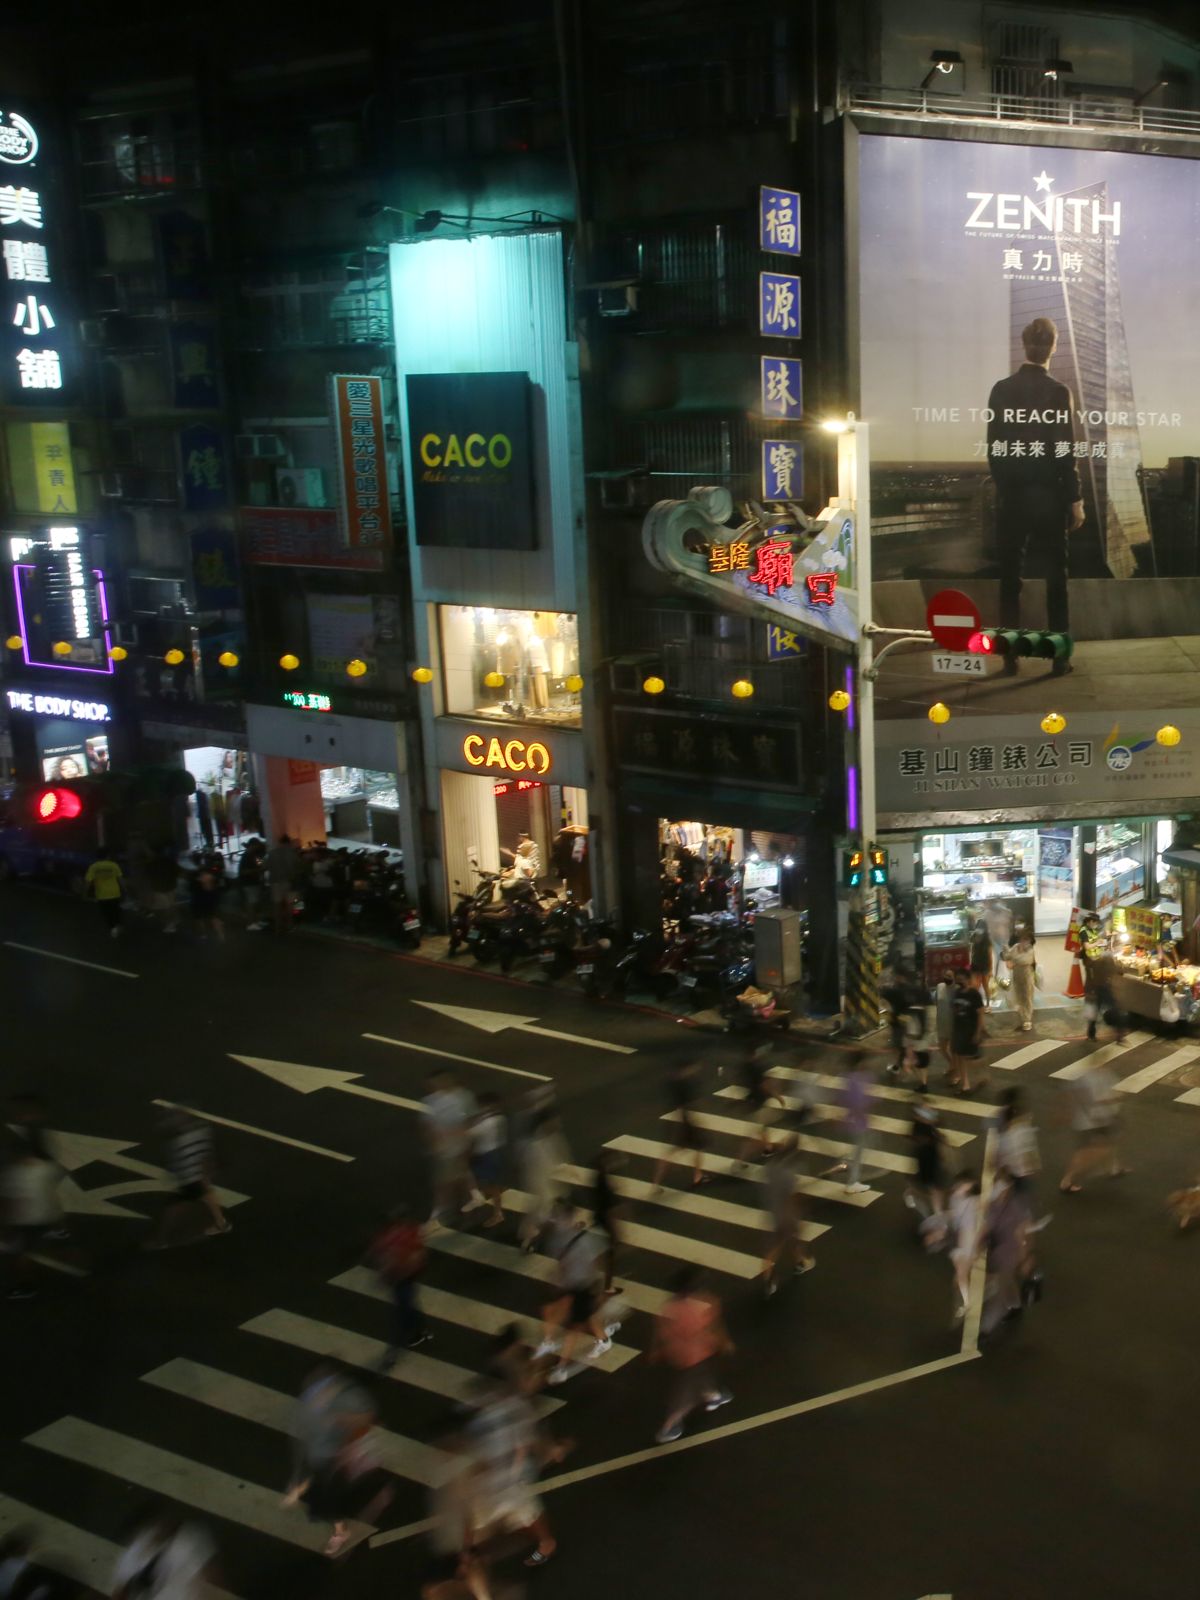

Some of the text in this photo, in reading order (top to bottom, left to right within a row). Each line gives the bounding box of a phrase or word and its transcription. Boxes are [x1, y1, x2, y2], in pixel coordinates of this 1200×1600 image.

[965, 192, 1121, 236] ZENITH
[1002, 248, 1084, 273] 真力時
[912, 408, 1182, 427] TIME TO REACH YOUR STAR
[420, 433, 512, 468] CACO
[973, 440, 1127, 459] 力創未來 夢想成真
[748, 539, 838, 606] 廟口
[936, 657, 982, 672] 17-24
[7, 691, 34, 710] THE
[34, 695, 72, 715] BODY
[463, 734, 552, 775] CACO
[900, 741, 1093, 777] 基山鐘錶公司
[933, 776, 981, 793] SHAN
[986, 774, 1048, 790] WATCH
